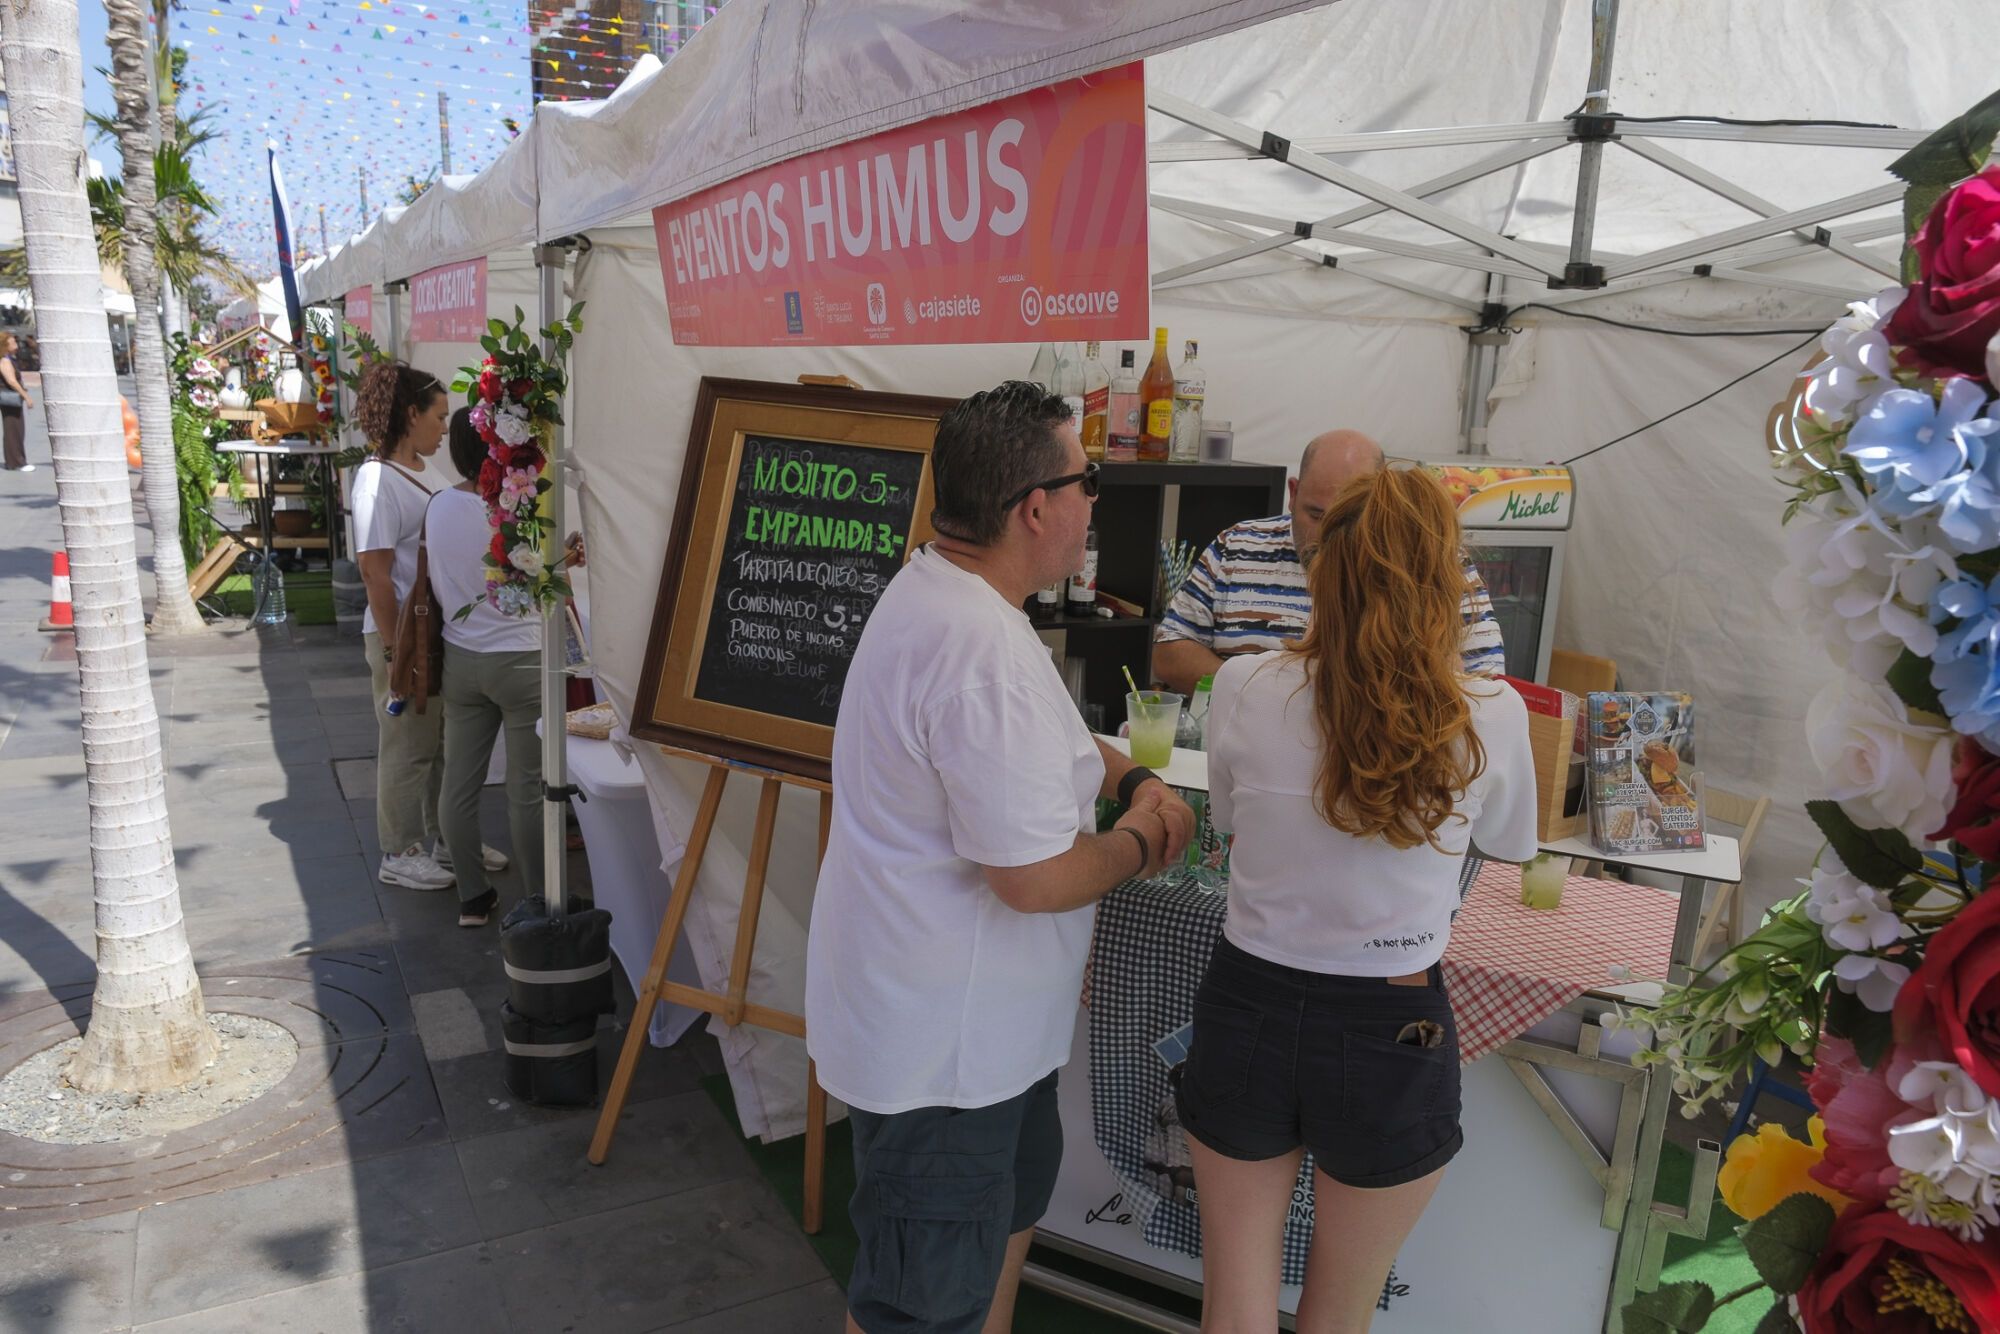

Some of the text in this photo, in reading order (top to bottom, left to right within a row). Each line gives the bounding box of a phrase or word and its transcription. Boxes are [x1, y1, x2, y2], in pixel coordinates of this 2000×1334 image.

[669, 118, 1029, 284] EVENTOS HUMUS
[438, 265, 476, 311] CREATIVE
[1045, 290, 1119, 315] ascoive
[919, 294, 981, 322] cajasiete
[754, 457, 857, 500] MOJITO
[1498, 490, 1560, 521] Michel
[745, 506, 873, 552] EMPANADA
[733, 550, 794, 584] TARTITA
[728, 588, 818, 620] COMBINADO
[730, 618, 844, 648] PUERTO DE INDIAS
[728, 640, 795, 662] GORDONS
[1661, 806, 1688, 815] BURGER
[1662, 814, 1693, 822] EVENTOS
[1663, 821, 1697, 830] CATERING
